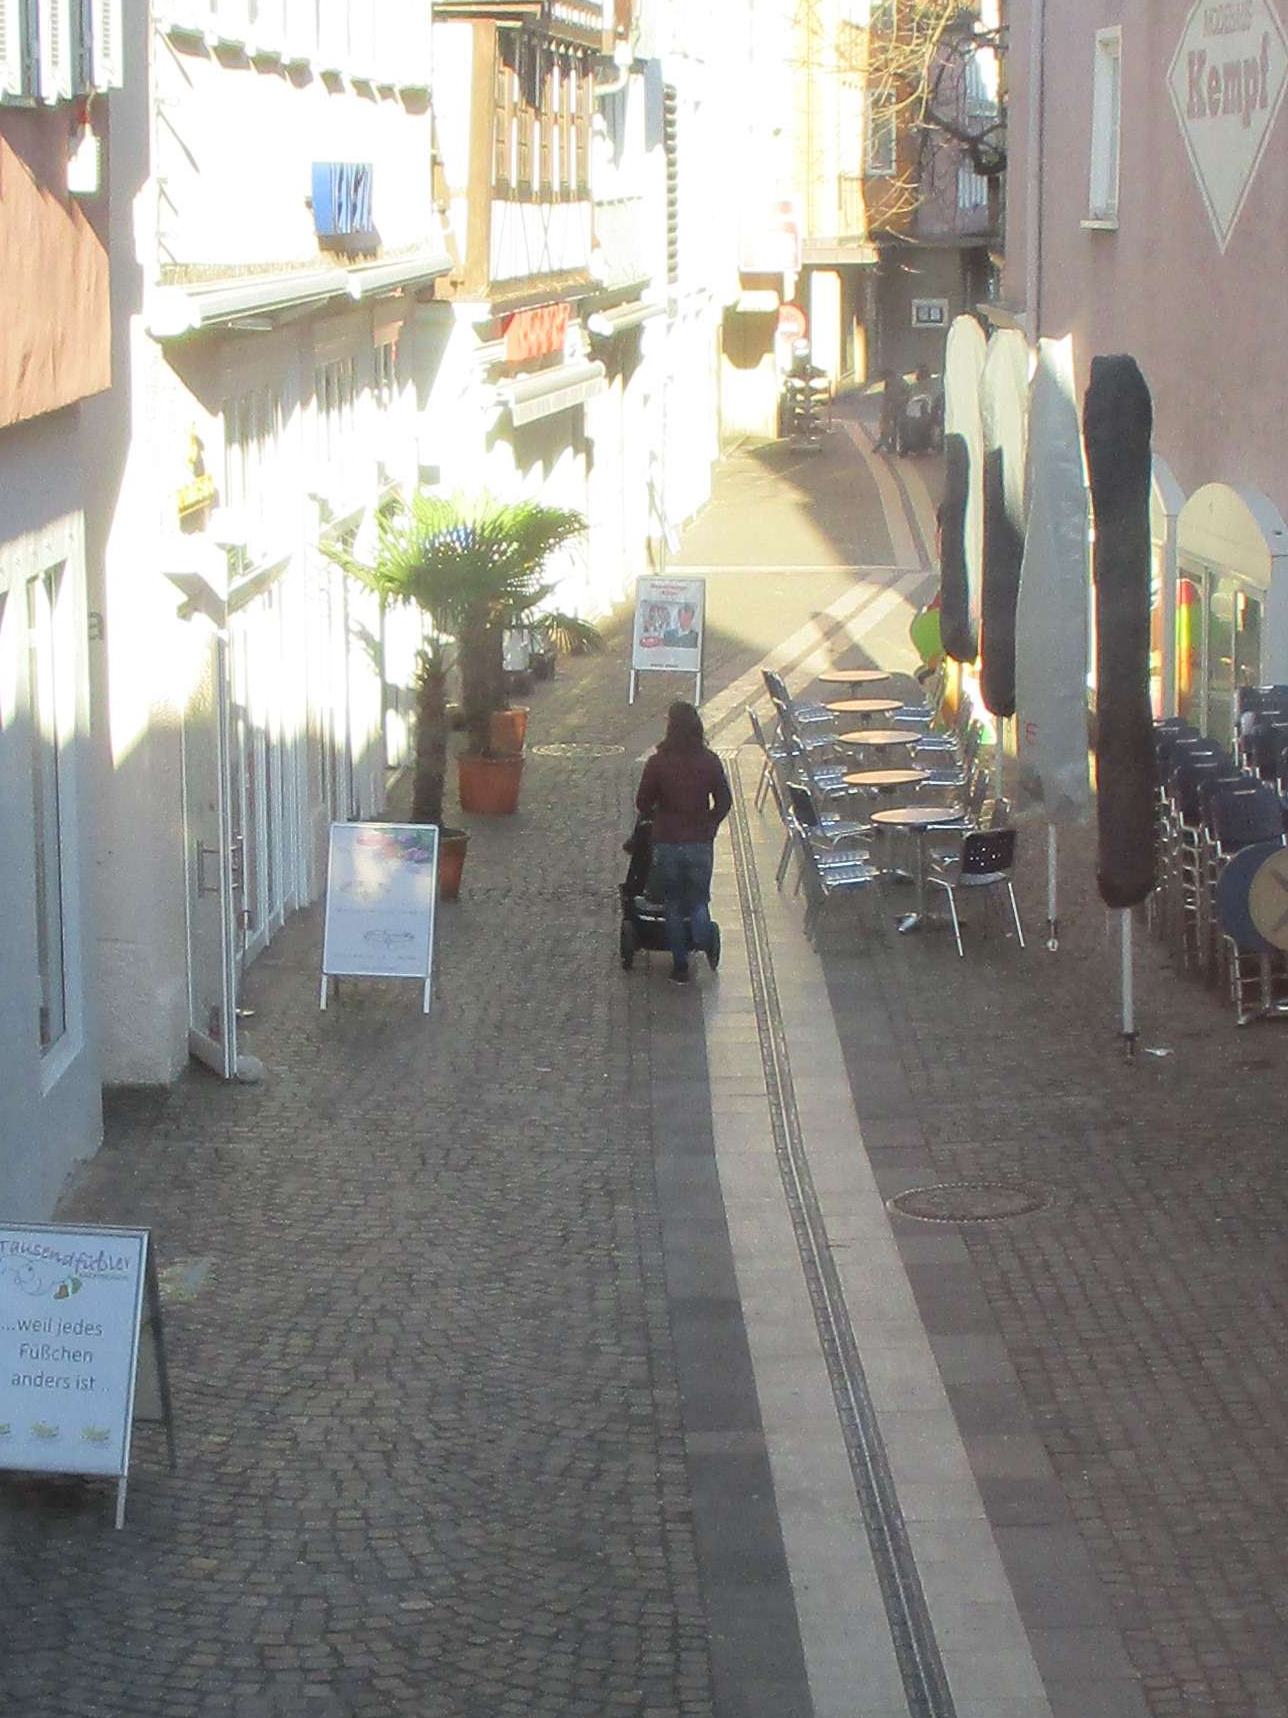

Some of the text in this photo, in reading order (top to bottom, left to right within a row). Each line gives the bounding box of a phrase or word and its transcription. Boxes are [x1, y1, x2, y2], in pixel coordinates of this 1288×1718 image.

[1187, 31, 1271, 130] Kempf
[56, 1318, 103, 1337] jedes
[12, 1372, 71, 1389] anders
[75, 1375, 95, 1390] ist
